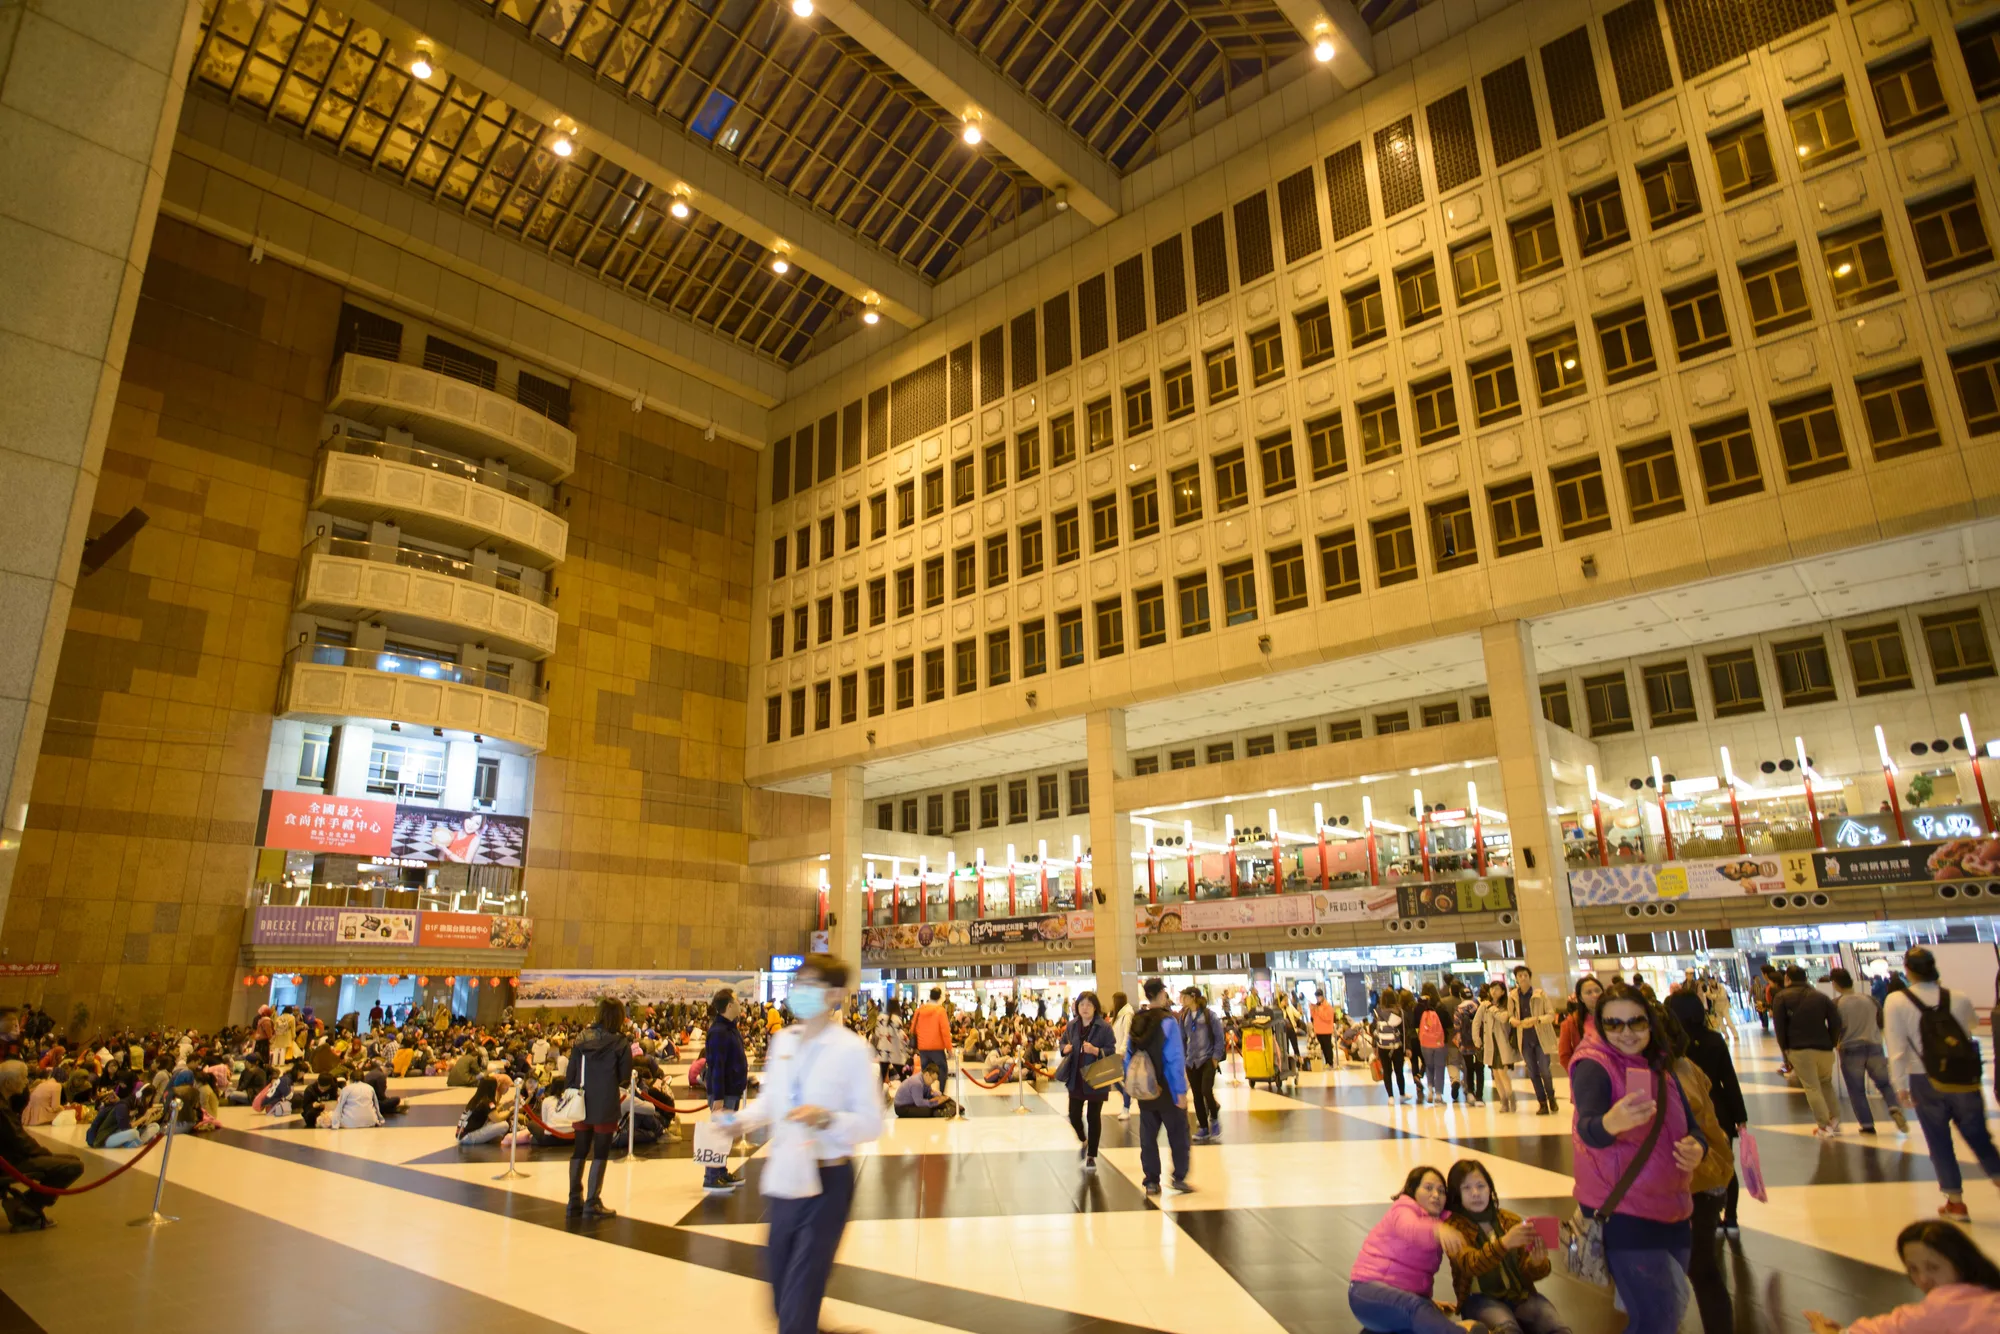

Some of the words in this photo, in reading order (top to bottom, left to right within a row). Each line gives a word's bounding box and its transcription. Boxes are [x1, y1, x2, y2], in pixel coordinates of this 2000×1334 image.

[308, 801, 364, 818] 全國最大
[284, 812, 382, 834] 食尚伴手禮中心
[1788, 858, 1806, 871] 1F
[260, 919, 298, 931] BREEZE
[305, 920, 335, 932] PLAZA
